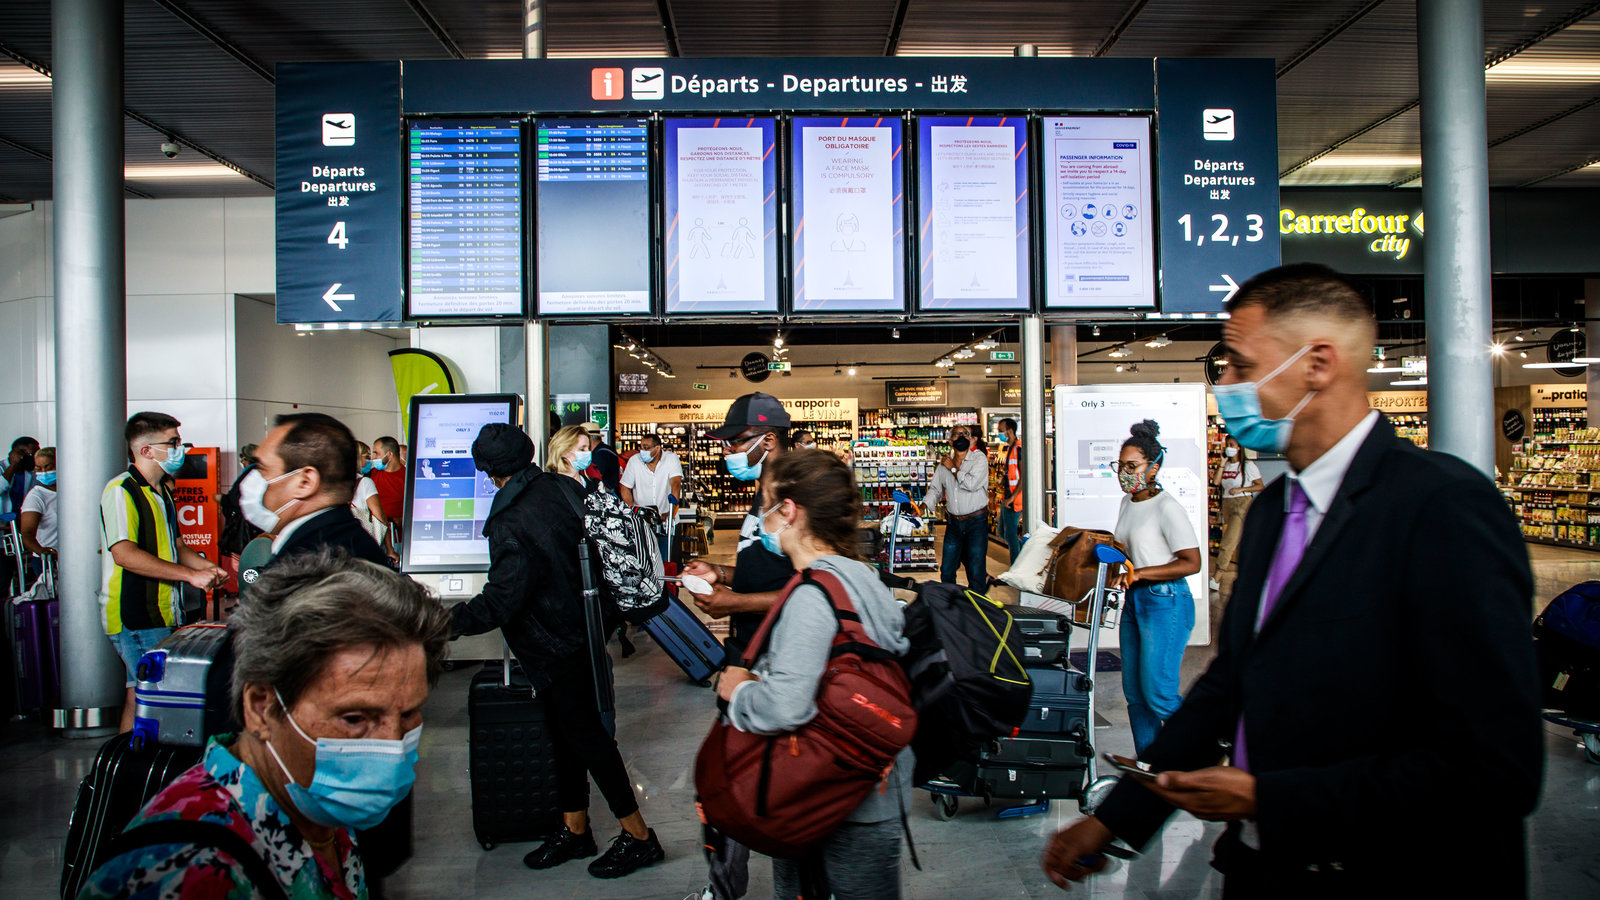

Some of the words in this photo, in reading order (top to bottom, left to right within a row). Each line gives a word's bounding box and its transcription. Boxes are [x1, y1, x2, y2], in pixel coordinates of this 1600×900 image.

[671, 74, 759, 95] Départs
[783, 74, 908, 96] Departures
[931, 75, 968, 93] 出发
[1194, 159, 1244, 173] Départs
[312, 166, 365, 180] Départs
[1184, 174, 1255, 187] Departures
[301, 181, 376, 195] Departures
[1209, 189, 1230, 200] 出发
[328, 196, 350, 207] 出发
[1280, 207, 1409, 234] Carrefour
[327, 221, 349, 250] 4
[1370, 235, 1410, 260] city
[794, 399, 840, 410] apporte
[1081, 400, 1098, 410] Orly
[1100, 400, 1105, 408] 3
[679, 412, 704, 420] ENTRE
[802, 409, 814, 420] LE
[817, 409, 836, 420] VIN
